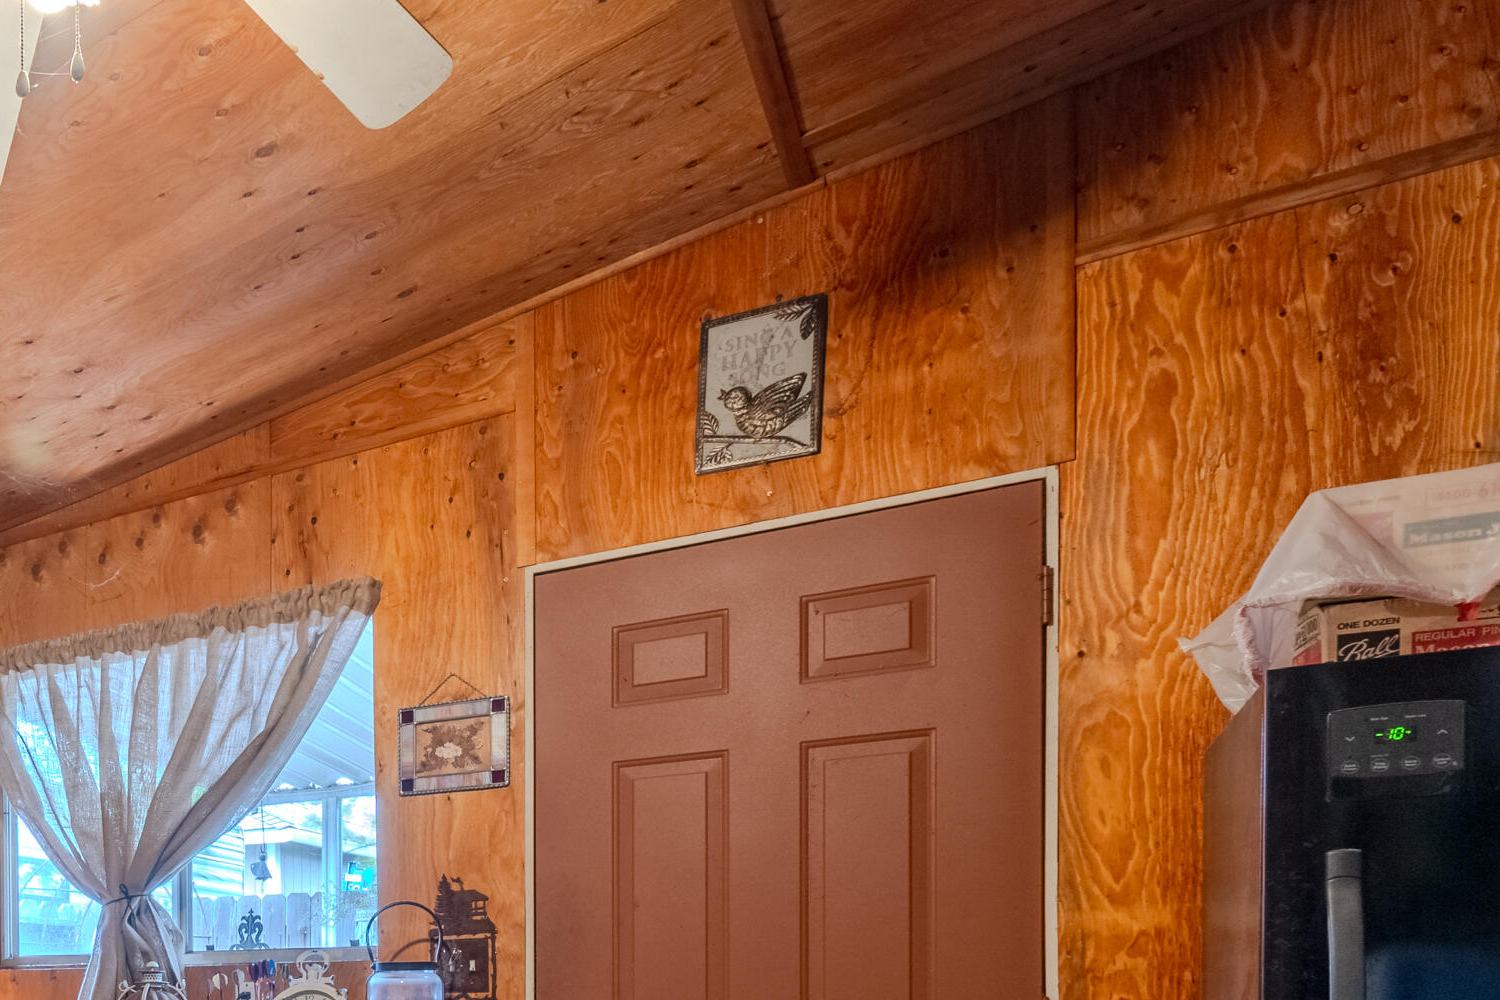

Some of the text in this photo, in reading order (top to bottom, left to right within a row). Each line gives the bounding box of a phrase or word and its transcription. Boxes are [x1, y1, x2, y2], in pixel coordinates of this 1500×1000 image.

[721, 339, 798, 372] HAPPY
[1336, 616, 1400, 630] ONE DOZEN
[1414, 628, 1476, 642] REGULAR
[1338, 634, 1400, 662] Ball
